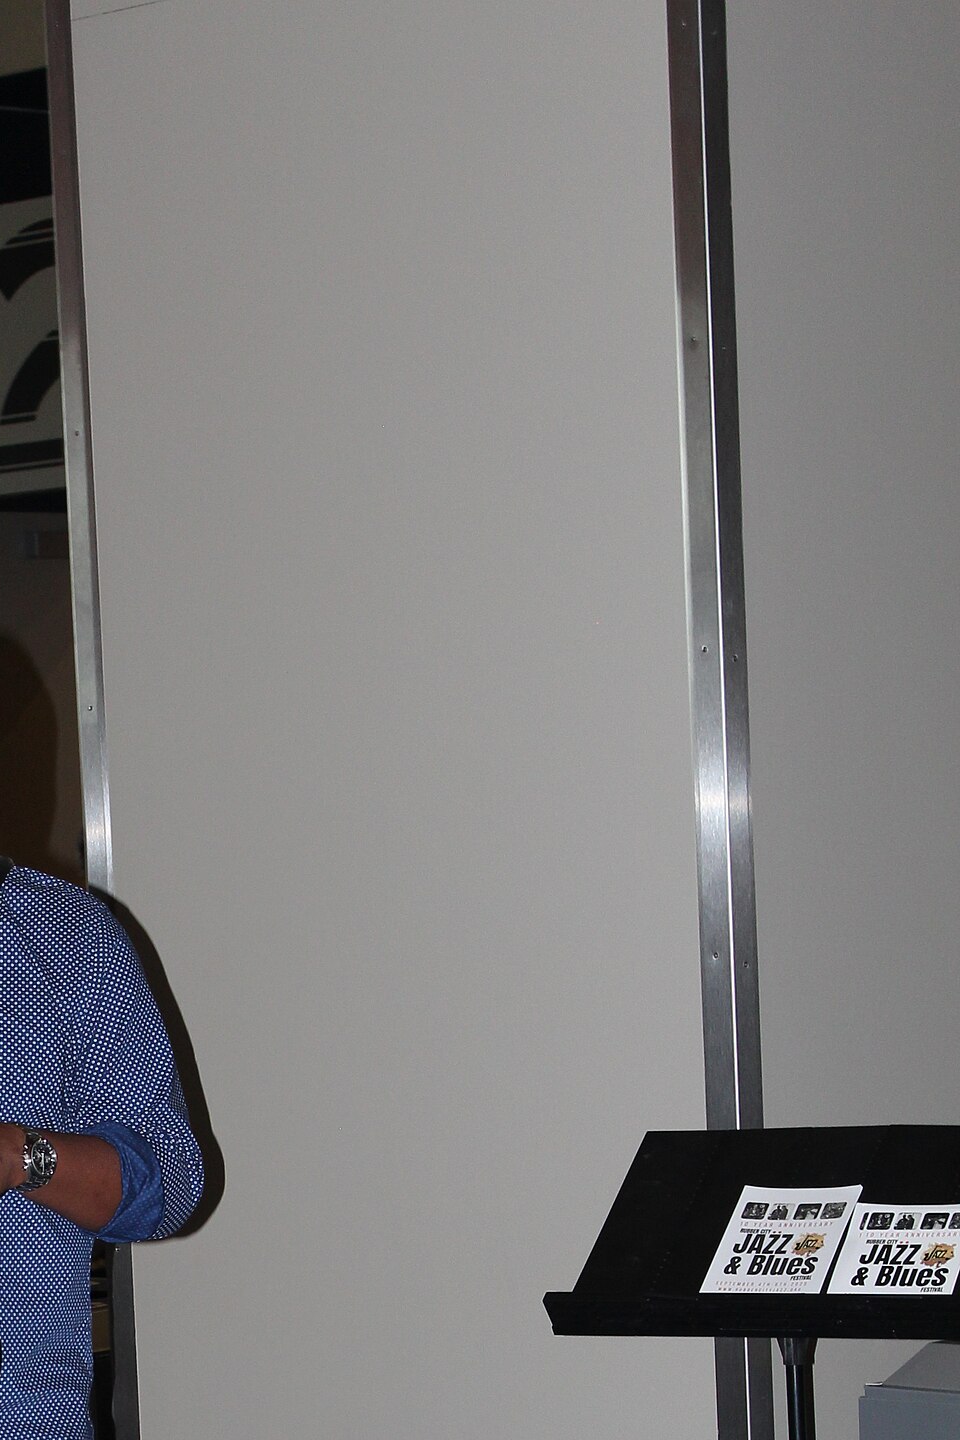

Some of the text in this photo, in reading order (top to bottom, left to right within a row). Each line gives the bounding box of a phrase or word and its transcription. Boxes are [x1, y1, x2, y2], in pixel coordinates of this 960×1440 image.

[732, 1233, 795, 1254] JAZZ
[723, 1254, 819, 1276] & Blues
[858, 1244, 922, 1265] JAZZ
[850, 1265, 950, 1287] & Blues
